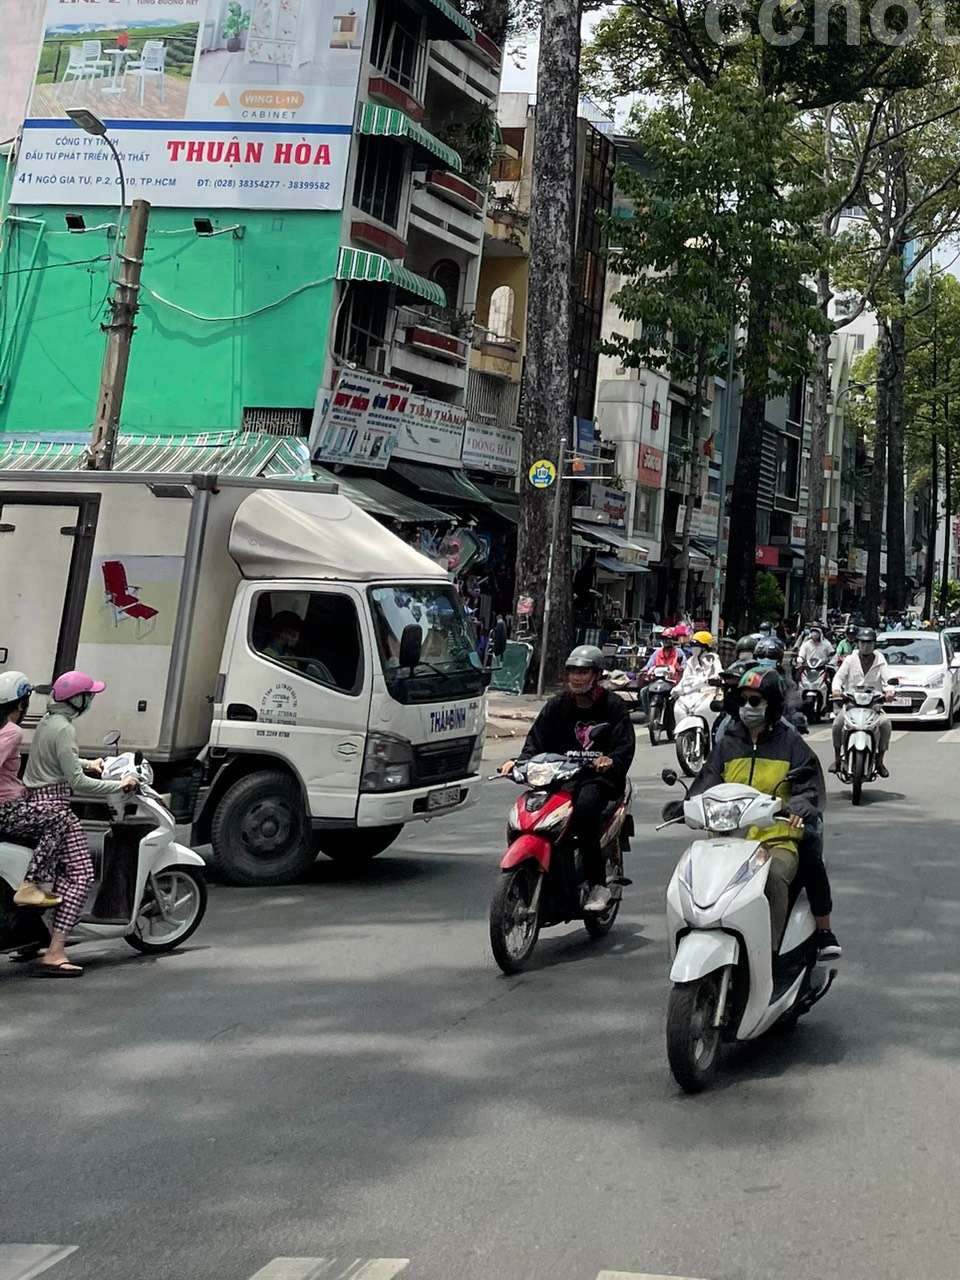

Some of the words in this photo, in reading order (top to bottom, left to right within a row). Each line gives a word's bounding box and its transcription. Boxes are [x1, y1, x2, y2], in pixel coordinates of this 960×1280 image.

[244, 95, 273, 104] WING
[241, 110, 297, 119] CABINET
[55, 136, 80, 146] CÔNG
[83, 137, 93, 146] TY
[167, 135, 264, 168] THUẬN
[273, 136, 331, 166] HÒA
[18, 172, 33, 184] 41
[59, 175, 75, 184] GIA
[140, 177, 177, 187] TP.HCM
[213, 179, 236, 189] (028)
[238, 179, 280, 189] 38354277
[287, 180, 331, 191] 38399582
